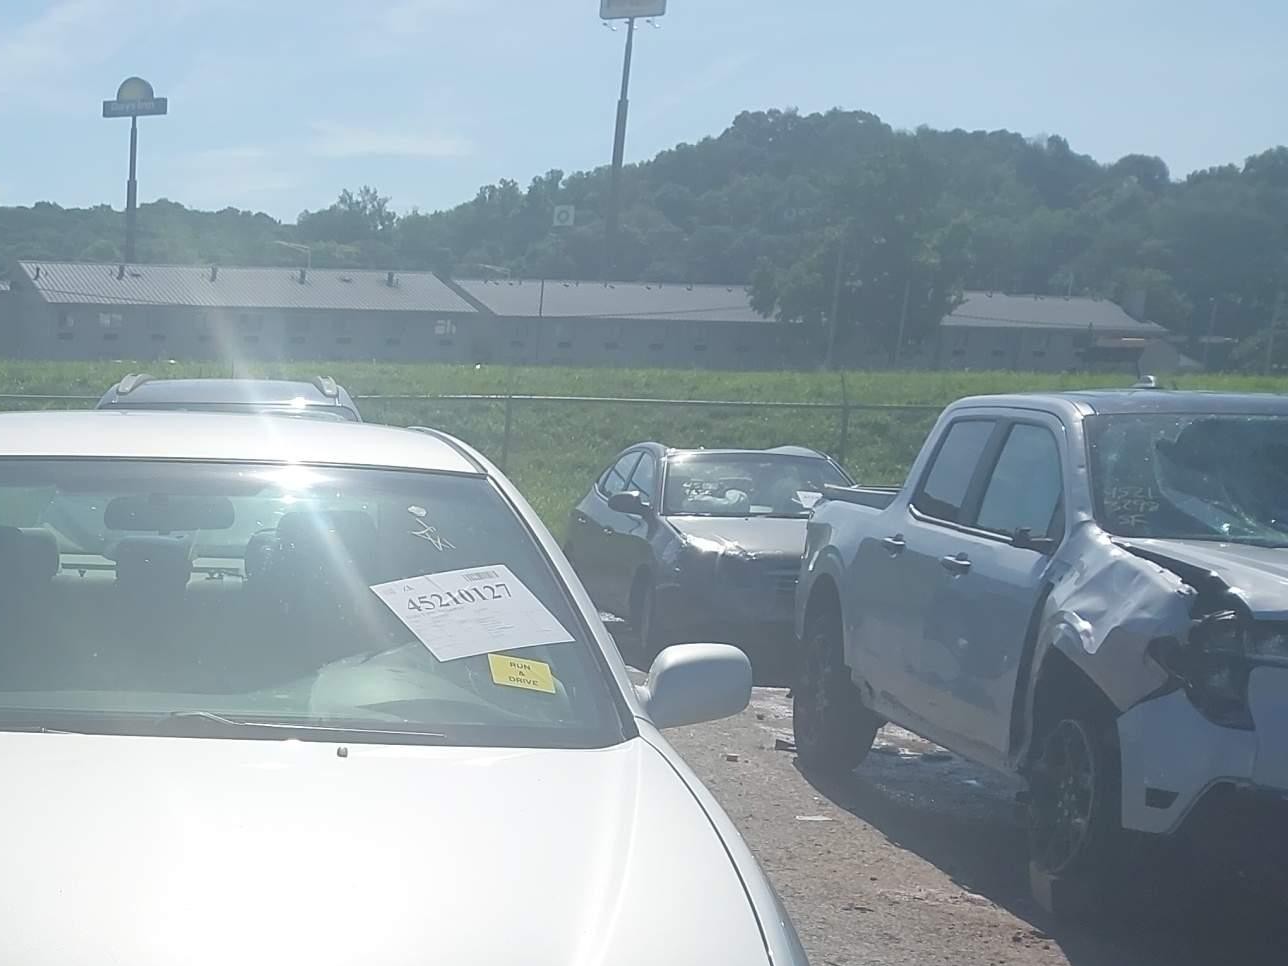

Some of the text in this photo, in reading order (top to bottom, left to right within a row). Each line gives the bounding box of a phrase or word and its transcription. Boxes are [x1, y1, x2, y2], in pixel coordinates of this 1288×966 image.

[407, 583, 513, 612] 45210127
[509, 661, 531, 671] RUN
[508, 675, 539, 687] DRIVE
